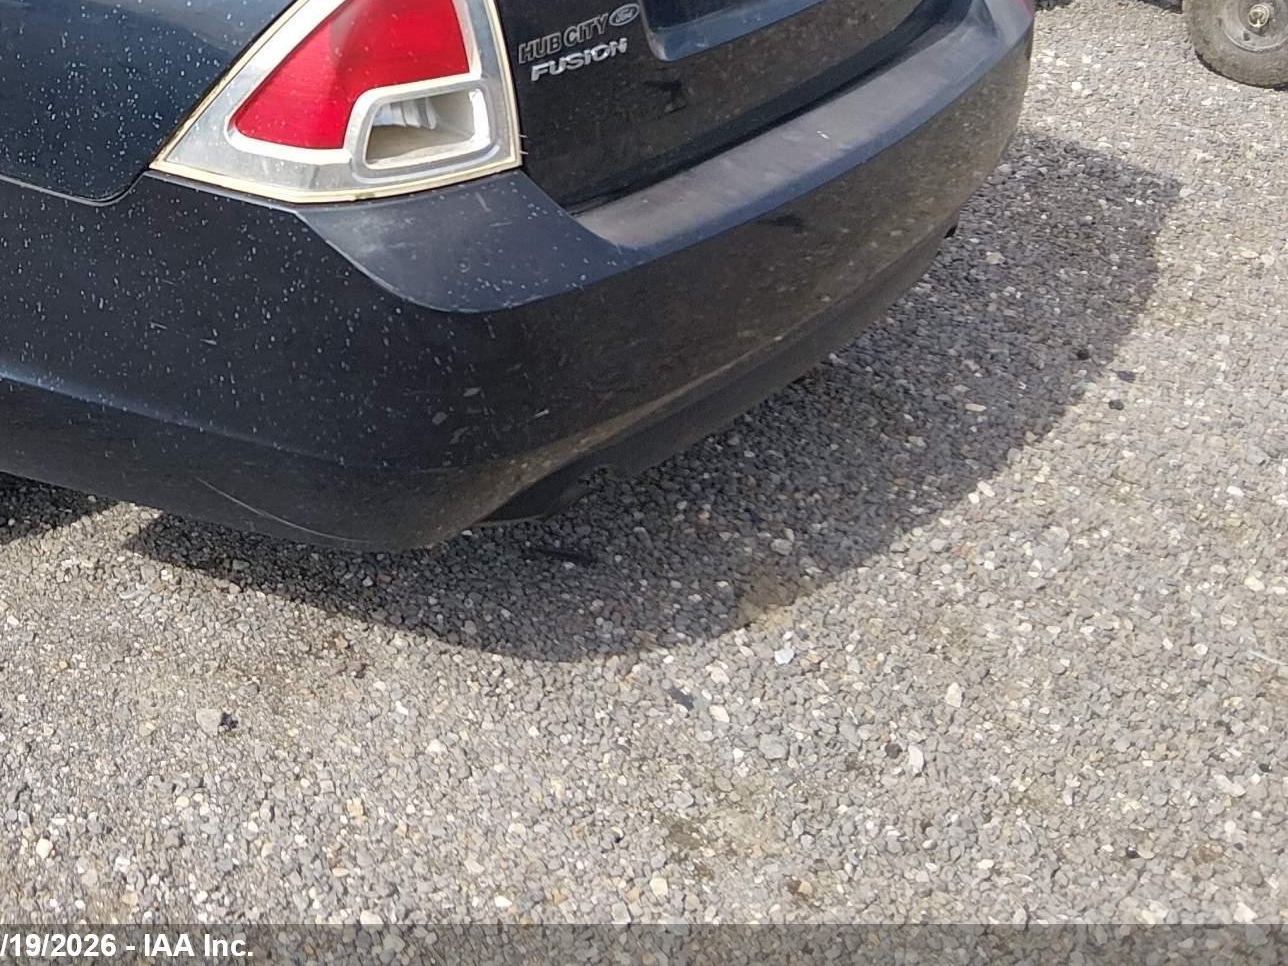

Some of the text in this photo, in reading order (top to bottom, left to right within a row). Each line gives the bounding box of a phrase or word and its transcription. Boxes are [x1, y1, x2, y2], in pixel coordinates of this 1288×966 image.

[518, 32, 562, 65] HUB
[563, 12, 609, 47] CITY
[530, 37, 628, 82] FUSION
